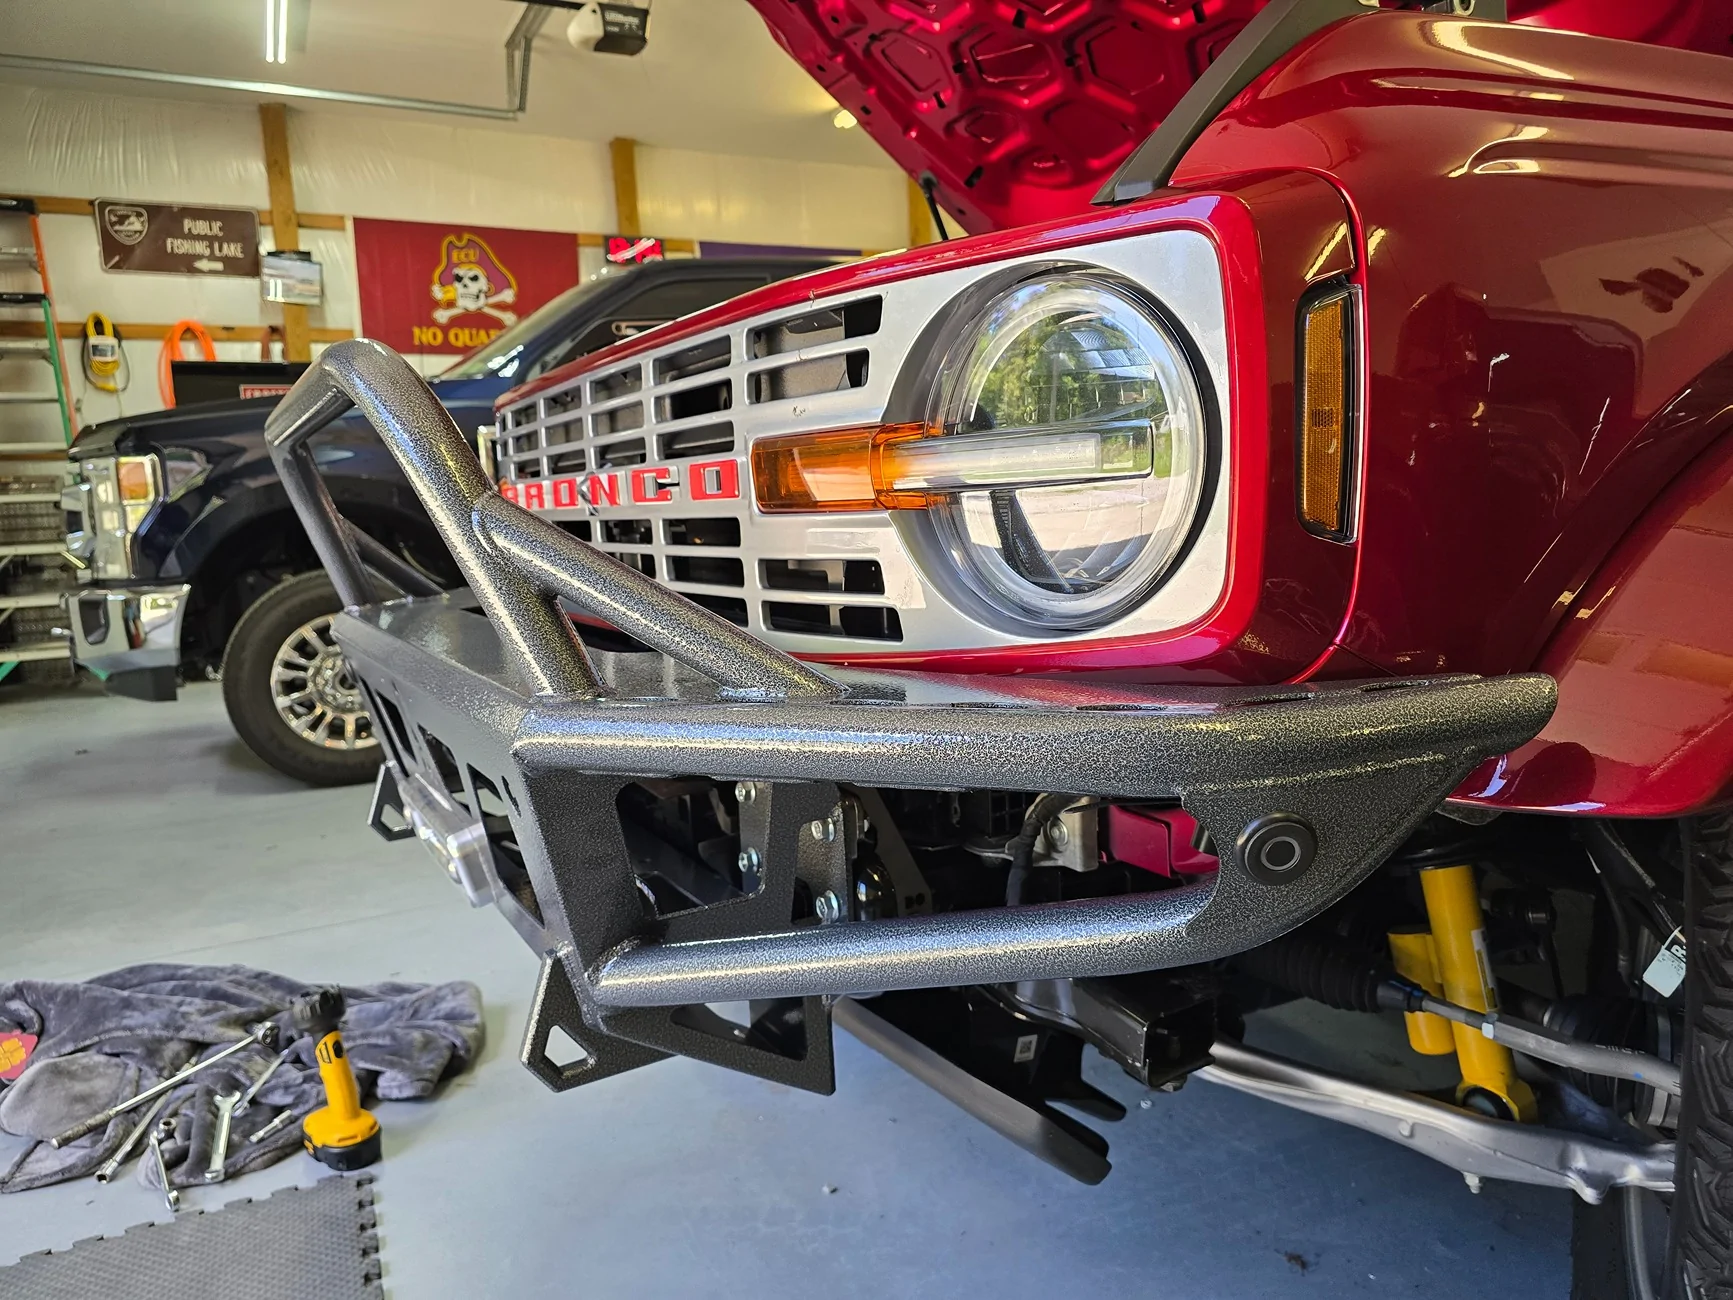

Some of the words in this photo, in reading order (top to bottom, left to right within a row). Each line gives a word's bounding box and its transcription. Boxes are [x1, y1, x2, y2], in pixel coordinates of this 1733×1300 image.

[183, 218, 224, 237] PUBLIC
[166, 237, 211, 257] FISHING
[213, 241, 245, 259] LAKE
[451, 248, 480, 264] ECU
[412, 325, 444, 346] NO
[502, 458, 741, 511] BRONCO
